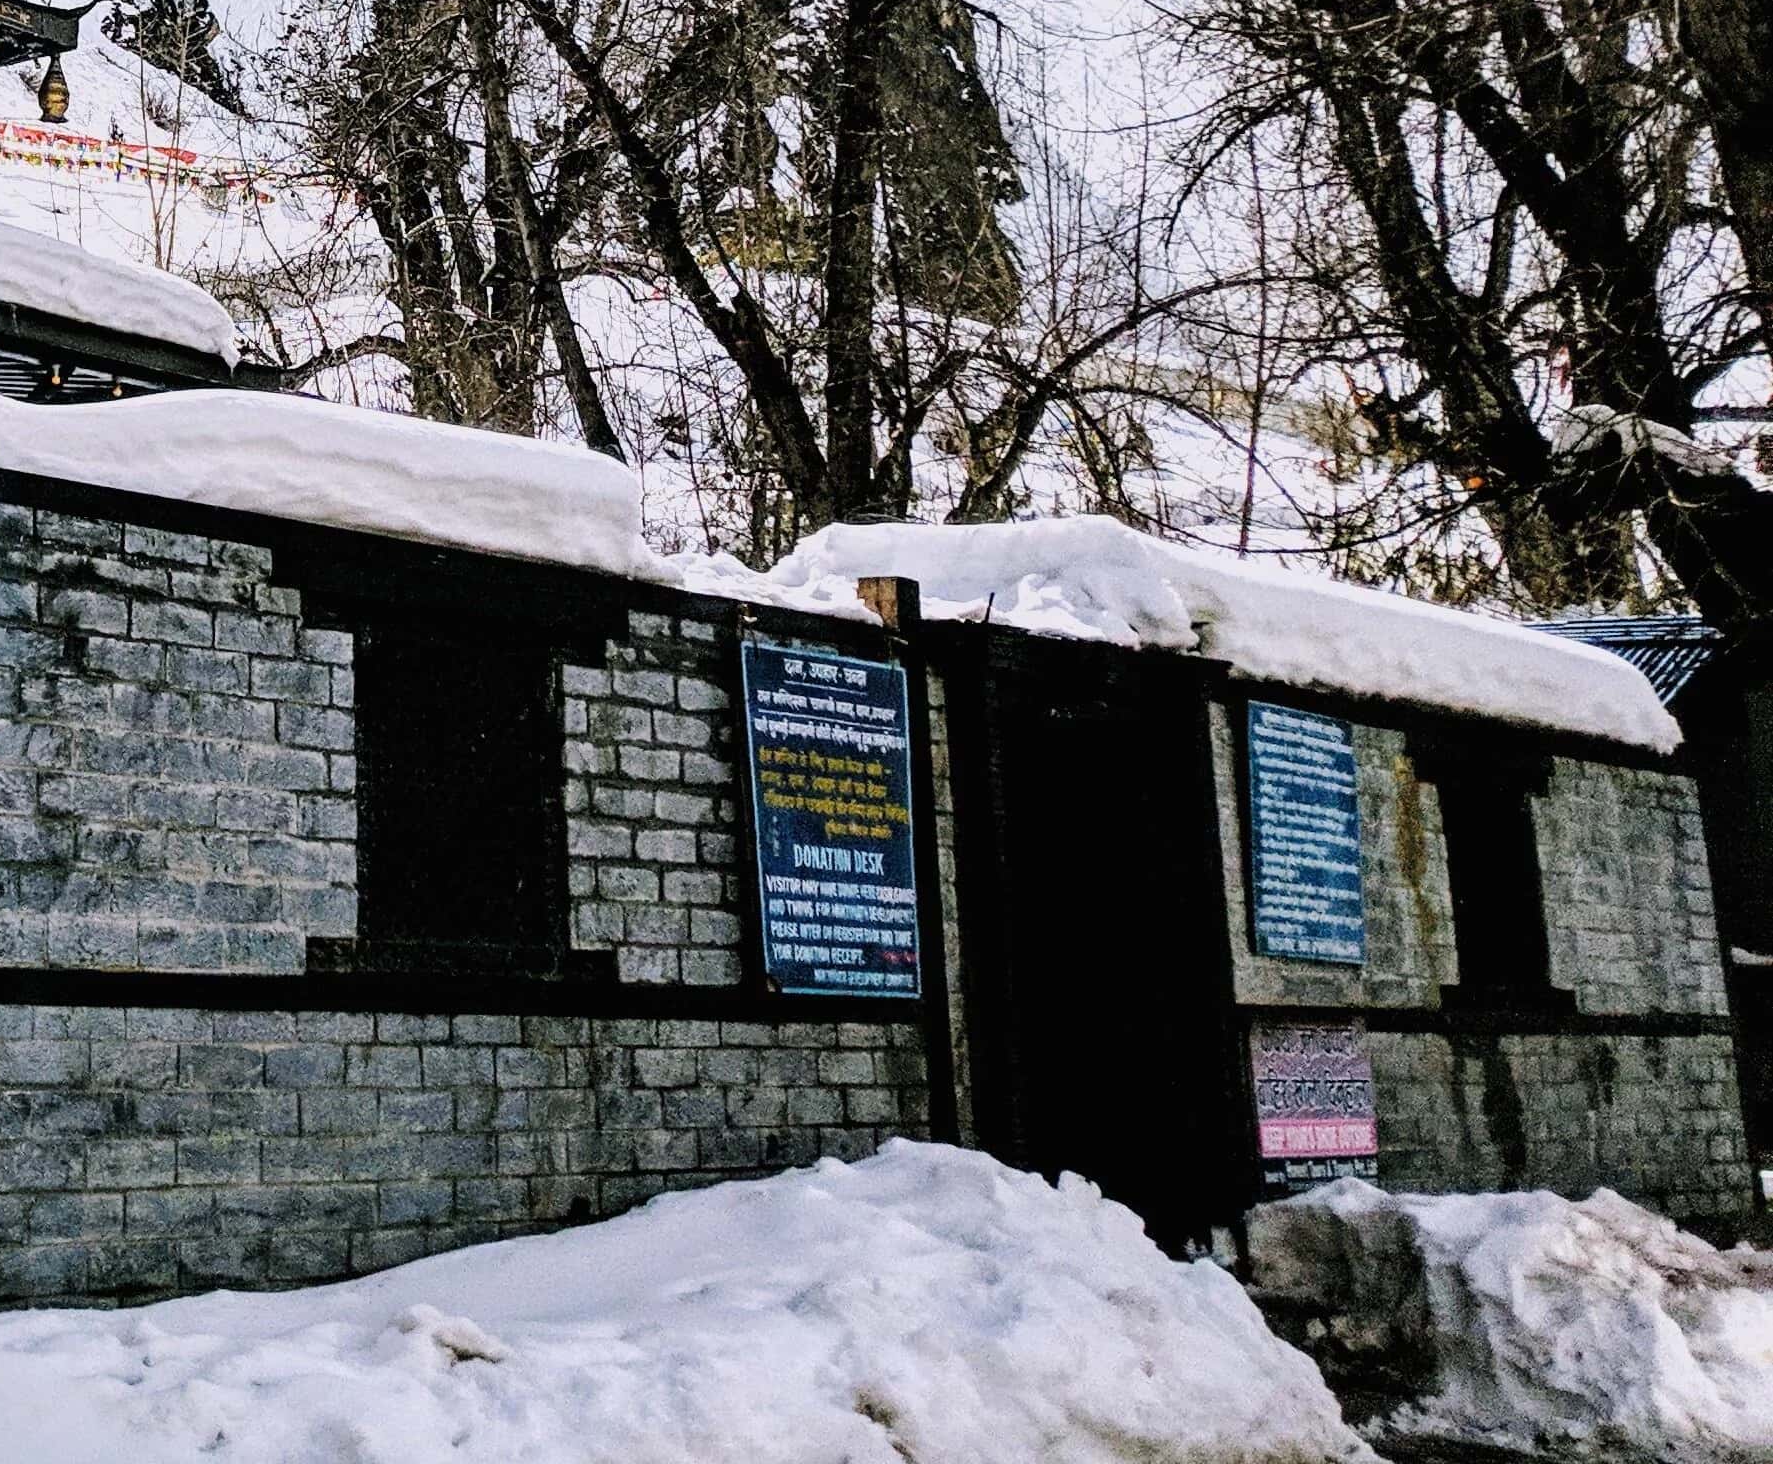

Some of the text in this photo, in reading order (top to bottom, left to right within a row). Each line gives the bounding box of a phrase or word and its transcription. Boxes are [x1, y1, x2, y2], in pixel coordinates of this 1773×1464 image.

[794, 844, 884, 876] DONATION DESK
[766, 874, 801, 894] VISITOR
[770, 920, 799, 938] PLEASE
